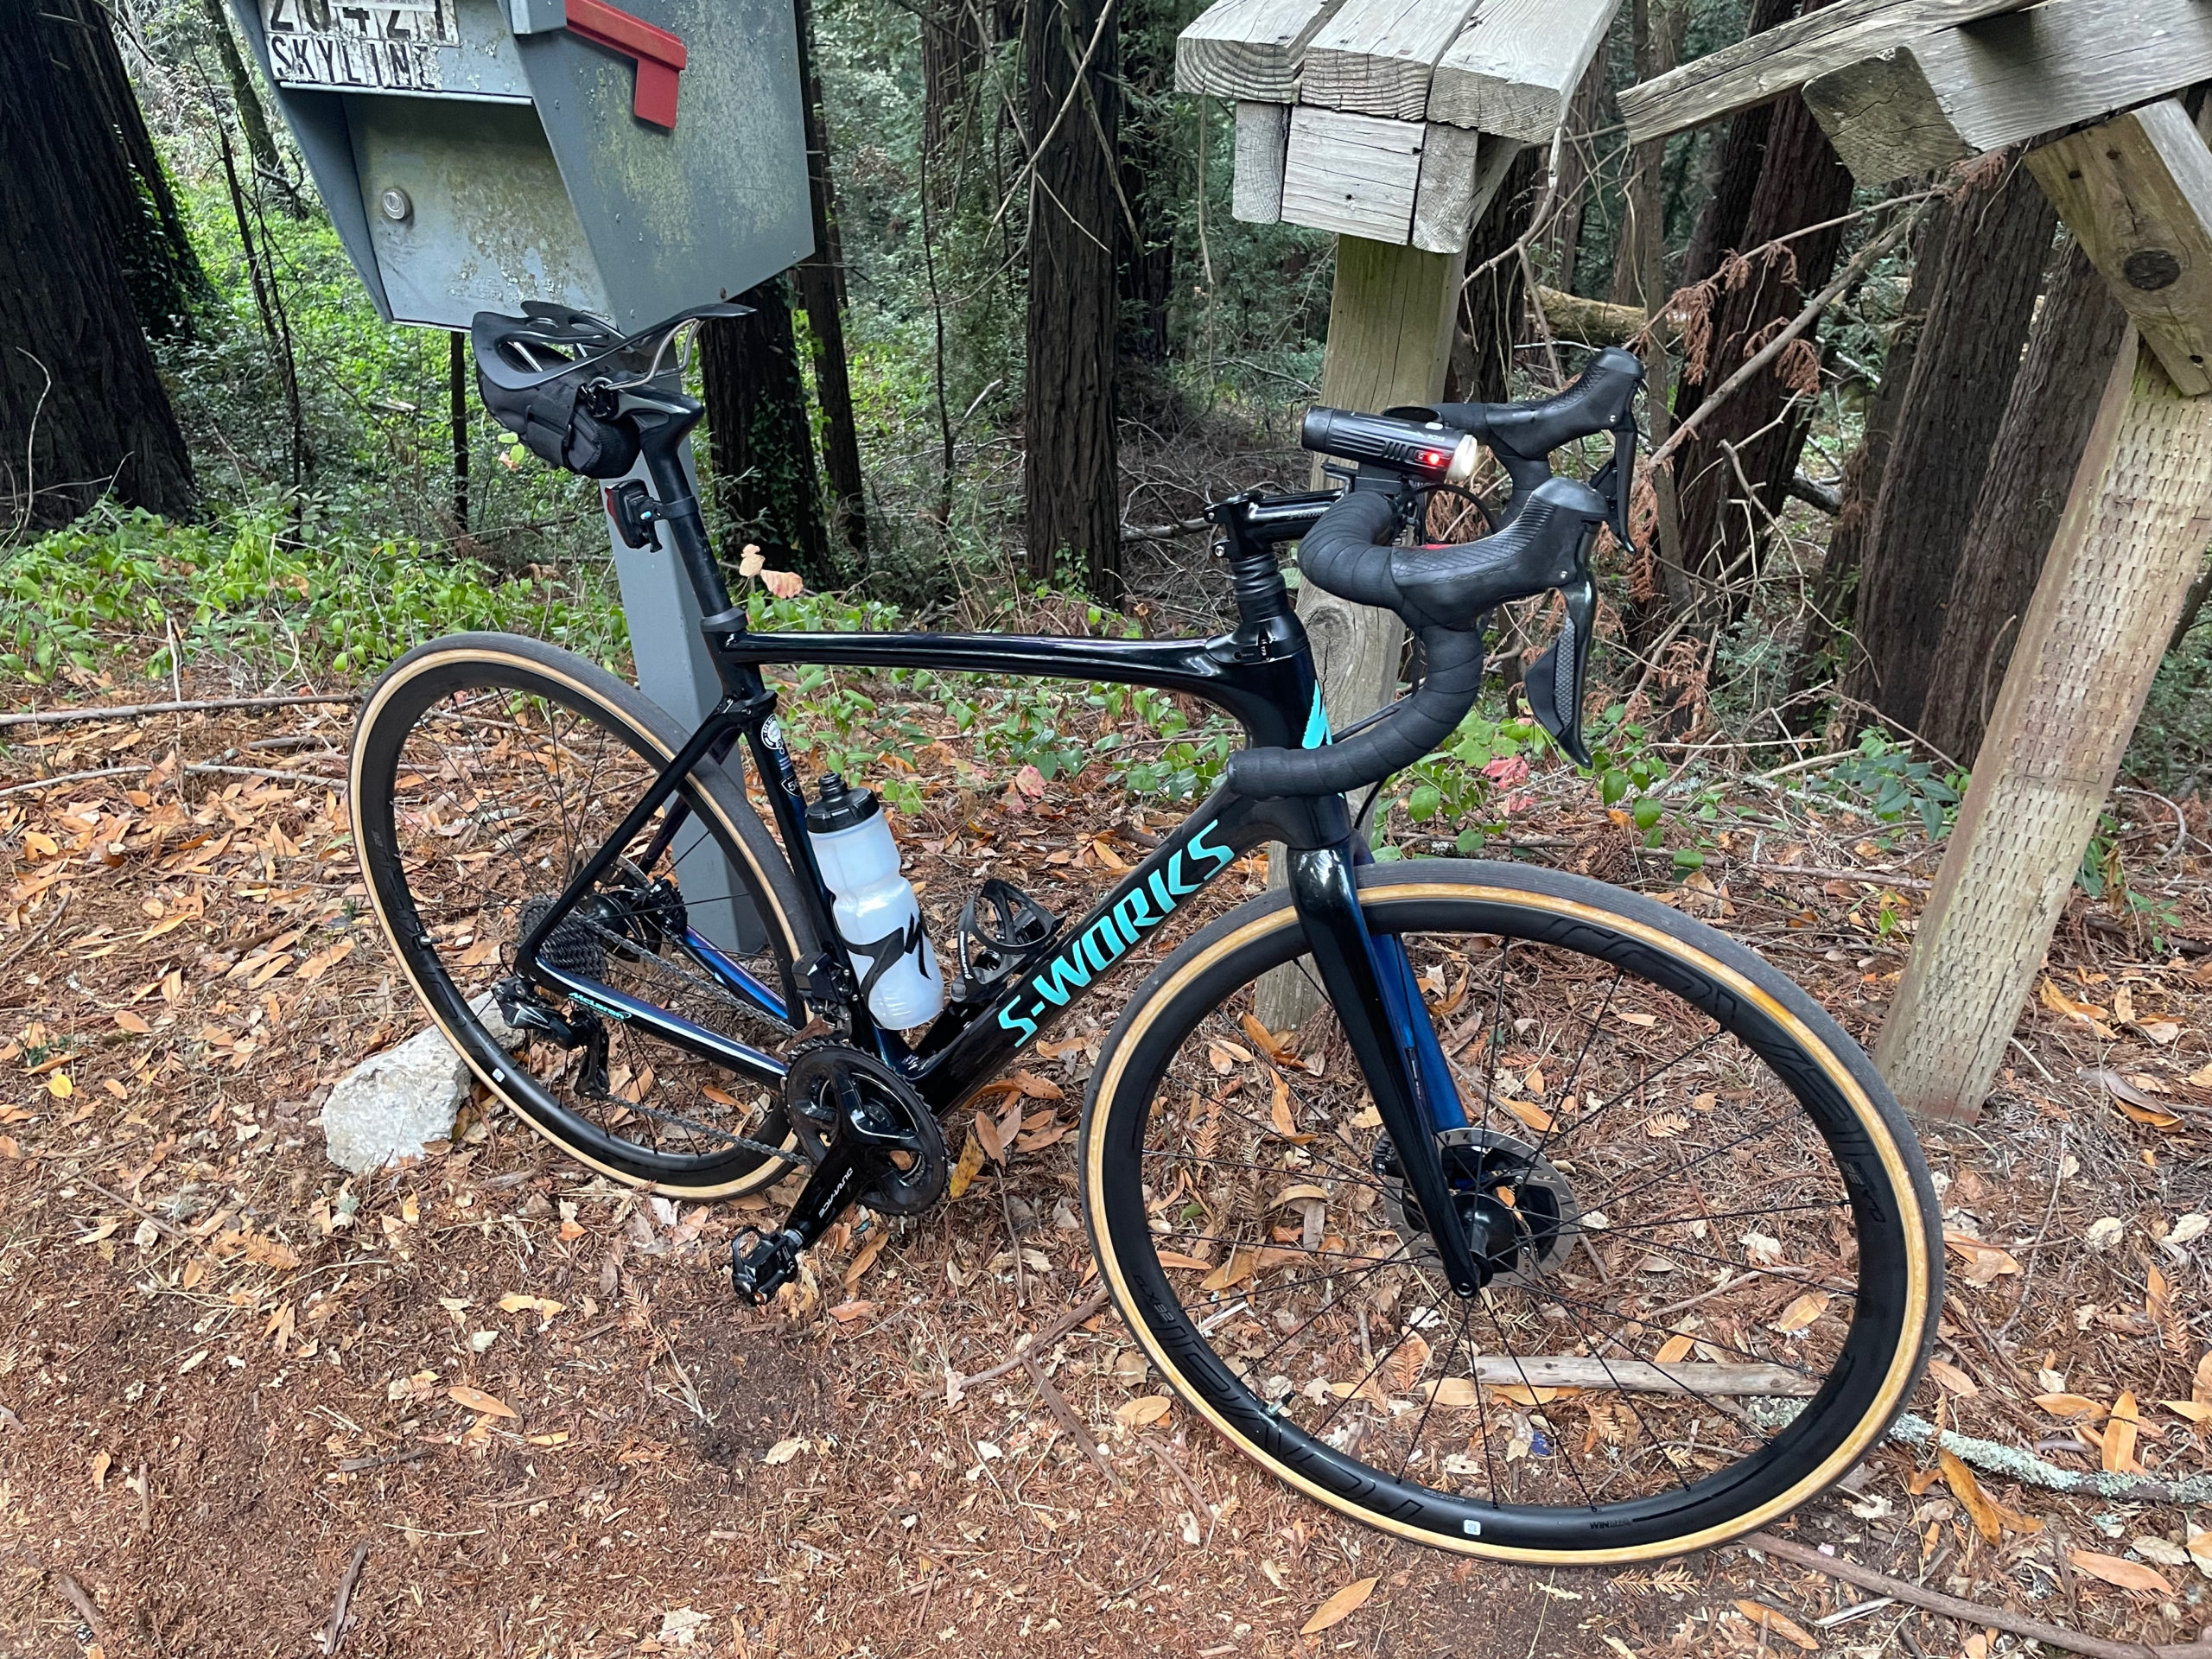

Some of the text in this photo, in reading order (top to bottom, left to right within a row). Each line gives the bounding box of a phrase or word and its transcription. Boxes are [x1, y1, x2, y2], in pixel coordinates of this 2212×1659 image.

[271, 35, 435, 88] SKYLINE
[997, 818, 1236, 1048] S-WORKS
[569, 992, 626, 1020] McLaren
